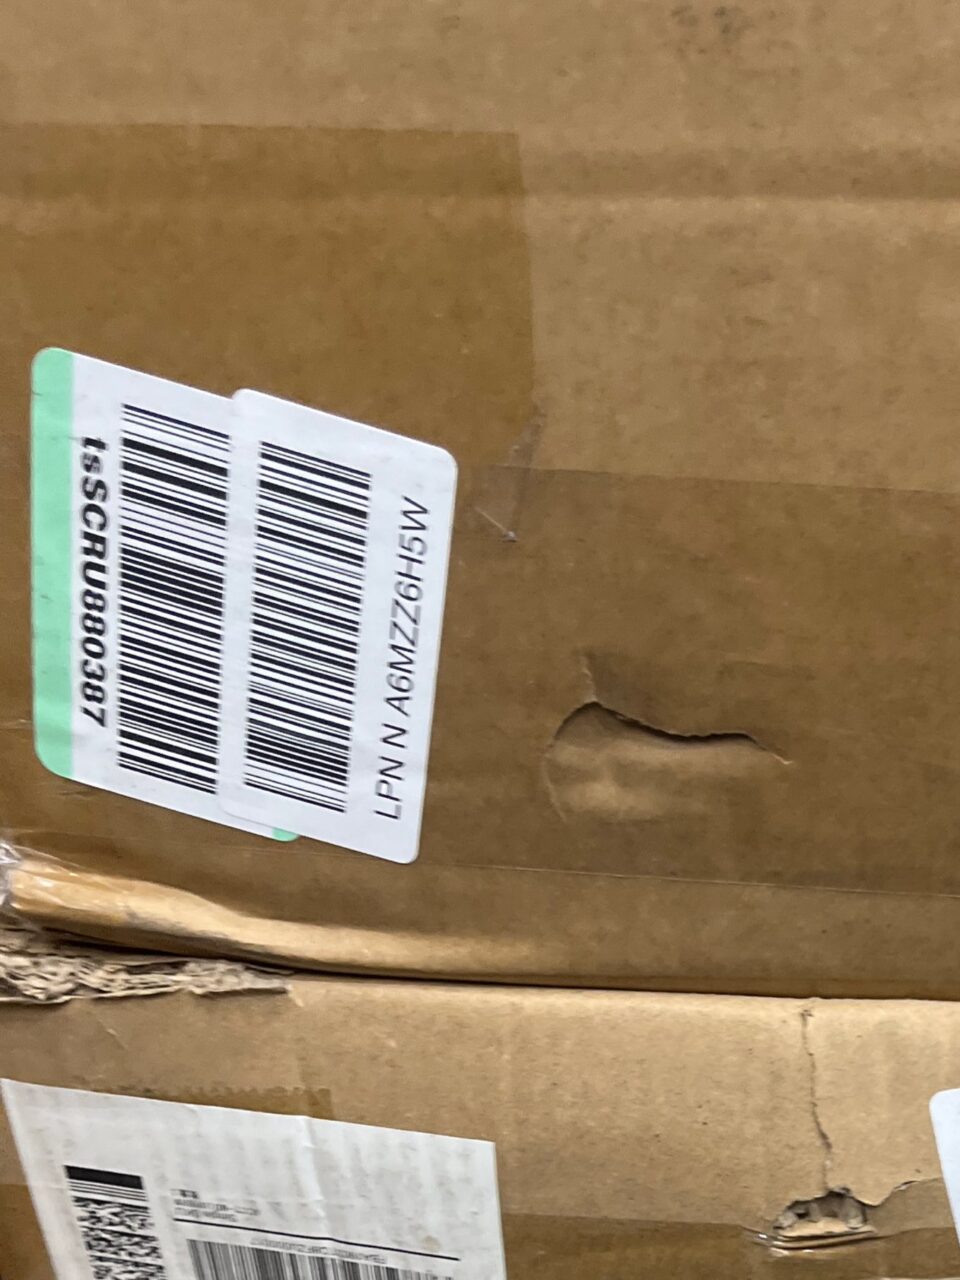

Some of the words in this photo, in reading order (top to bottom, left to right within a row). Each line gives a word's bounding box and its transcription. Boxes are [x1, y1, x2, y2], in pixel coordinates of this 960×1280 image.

[79, 436, 108, 728] tsSCRU880387
[384, 496, 430, 717] A6MZZ6H5W
[373, 756, 405, 820] LPN
[380, 722, 409, 750] N
